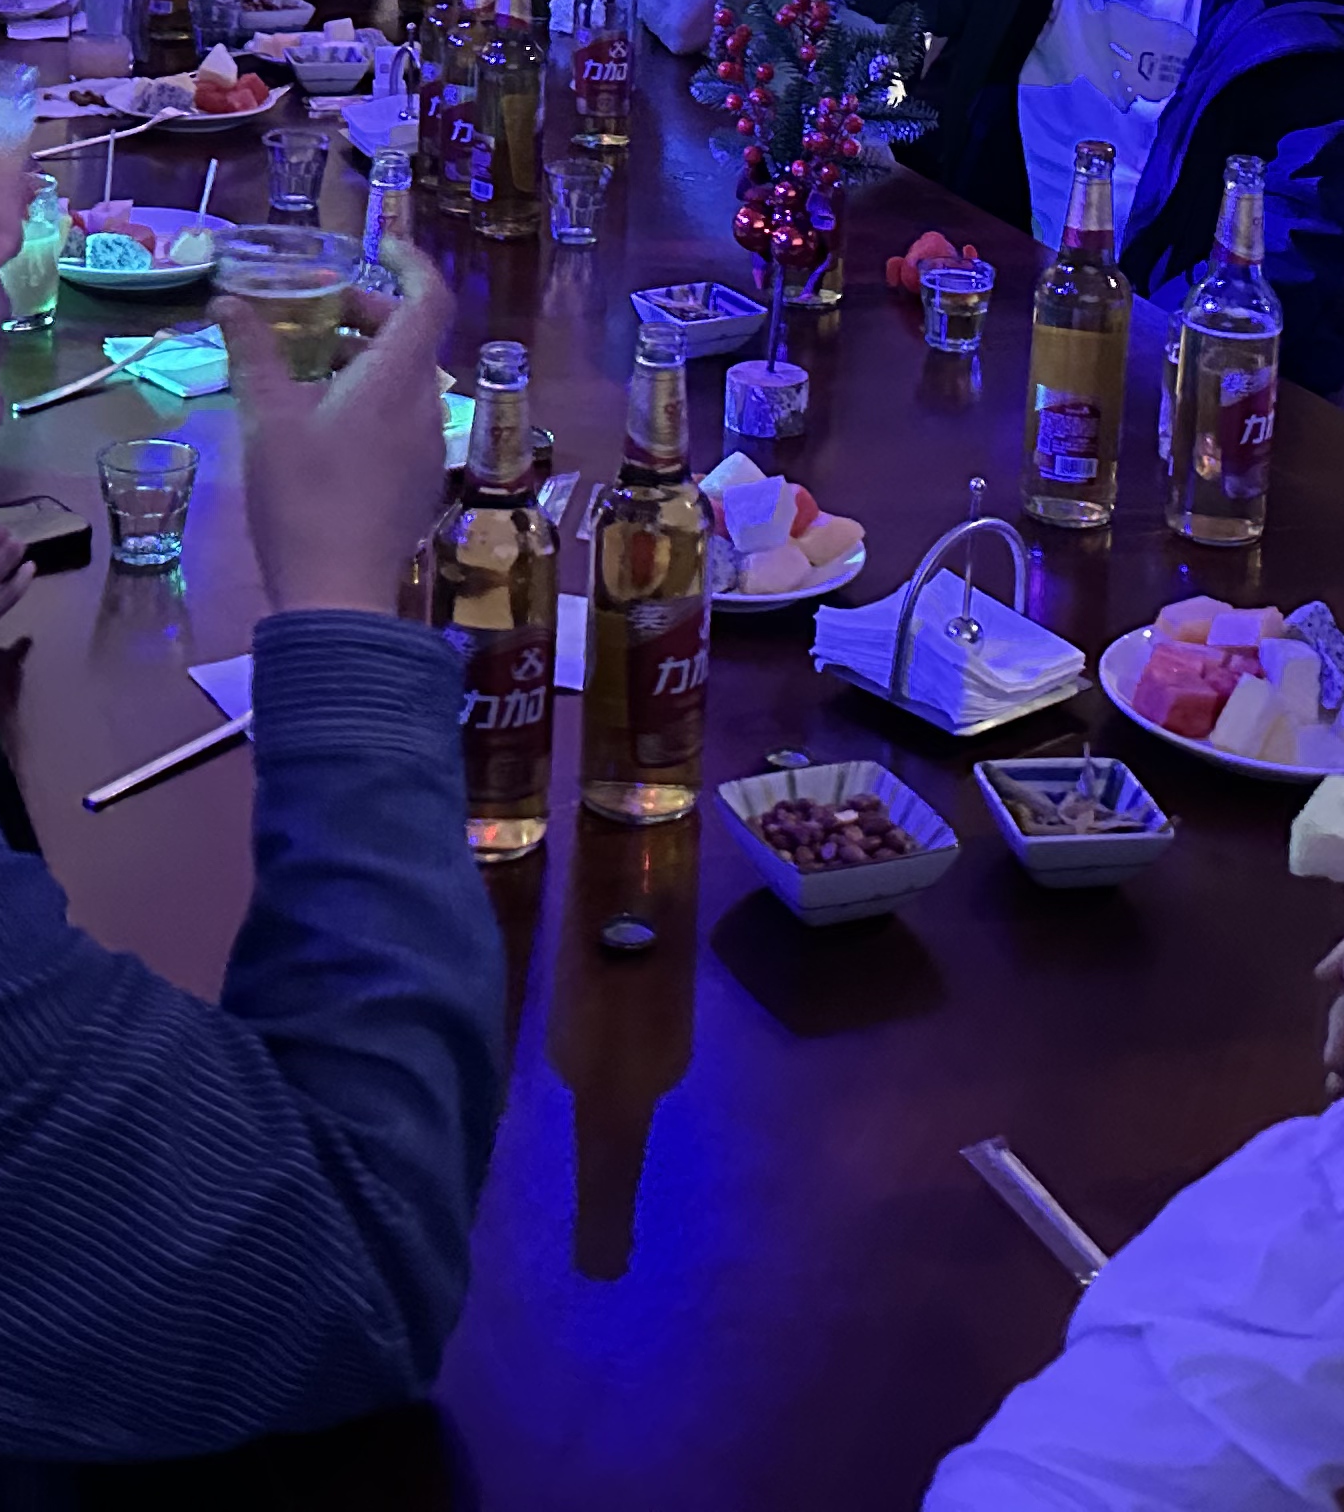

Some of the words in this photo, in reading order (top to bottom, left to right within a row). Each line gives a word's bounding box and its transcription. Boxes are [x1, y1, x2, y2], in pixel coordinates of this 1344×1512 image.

[582, 59, 628, 81] 力加
[451, 119, 474, 142] 力
[458, 686, 547, 729] 力加
